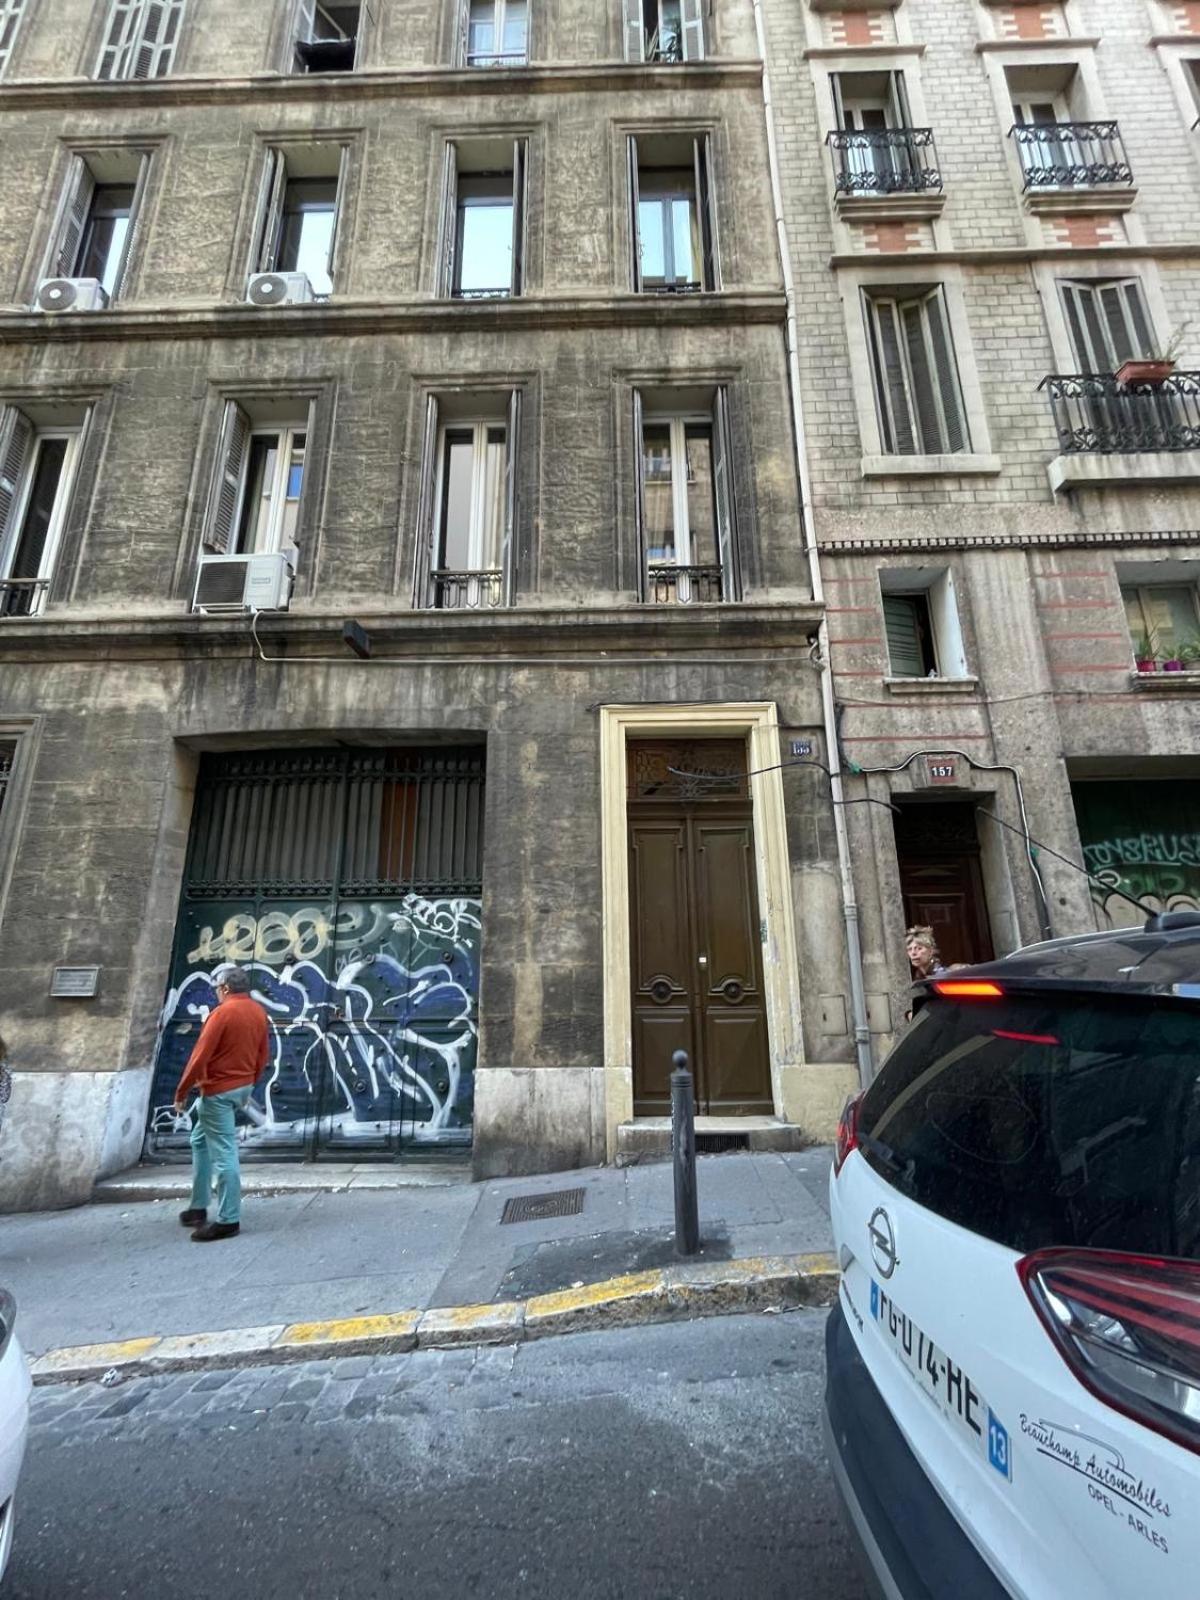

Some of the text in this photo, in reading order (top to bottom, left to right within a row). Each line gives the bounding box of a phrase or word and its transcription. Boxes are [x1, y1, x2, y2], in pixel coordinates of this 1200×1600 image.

[931, 766, 952, 777] 157
[1085, 1453, 1172, 1518] Automobiles
[1087, 1483, 1117, 1516] OPEL
[1128, 1514, 1169, 1554] ARLES
